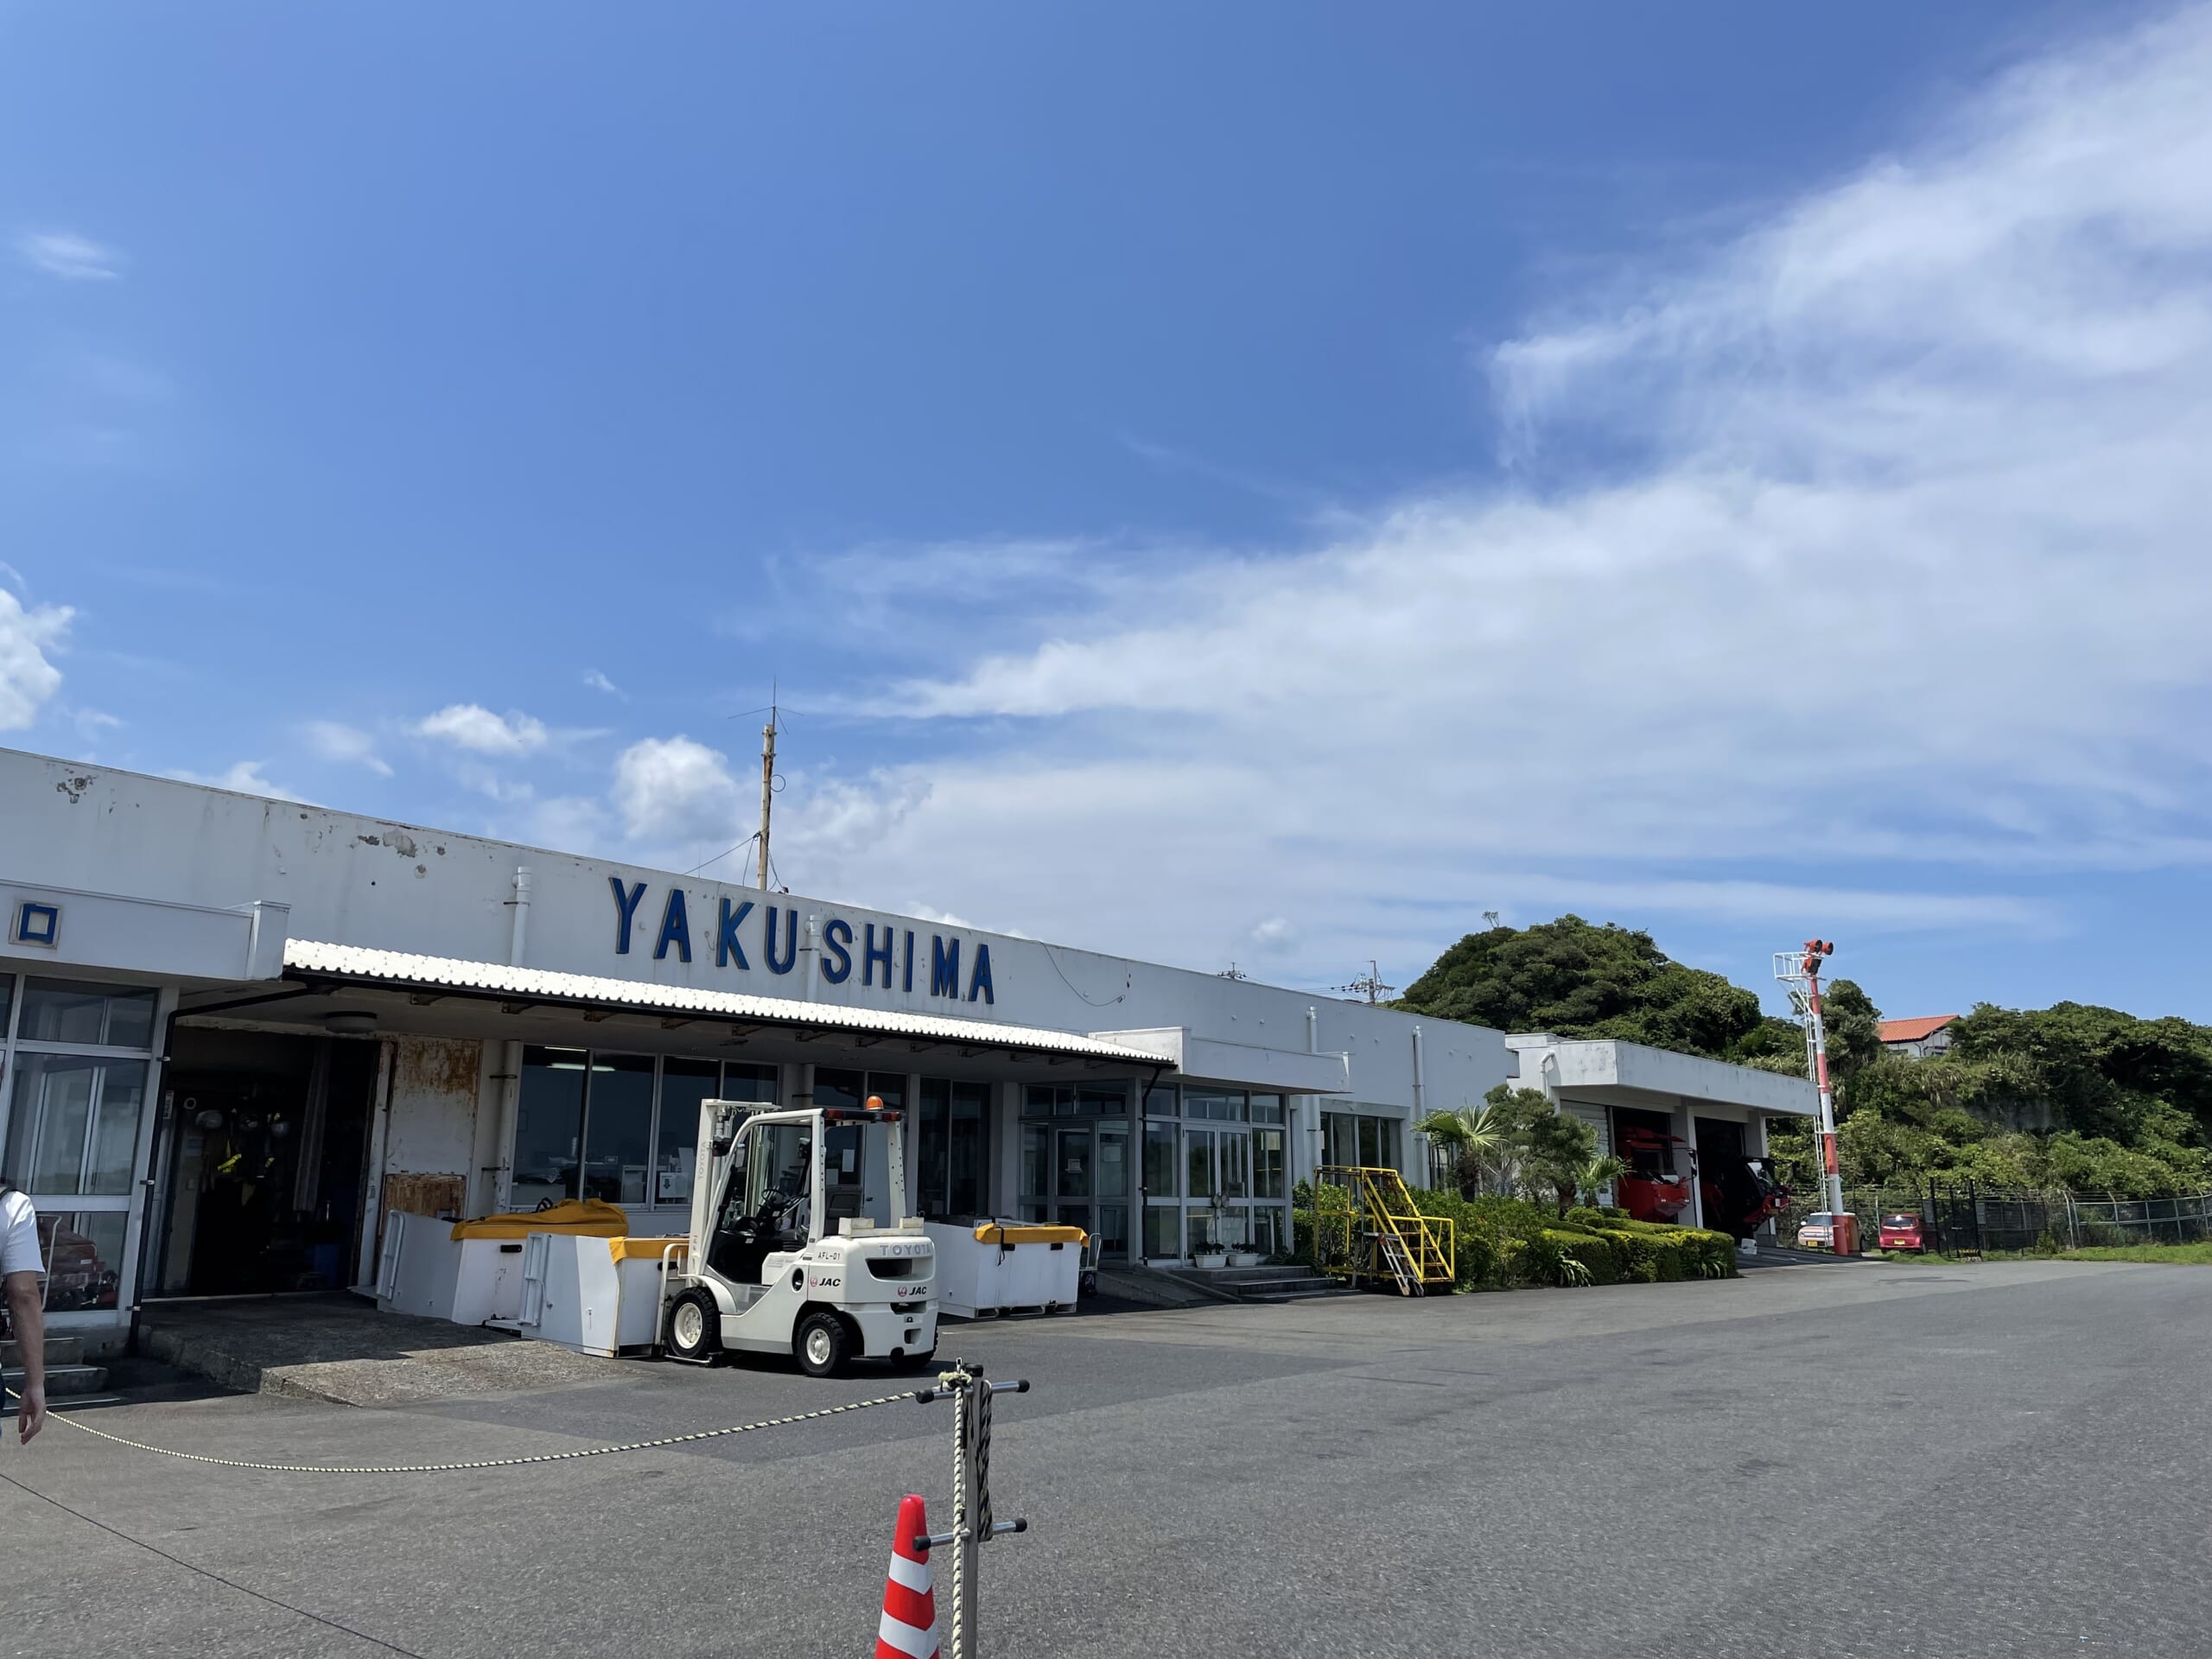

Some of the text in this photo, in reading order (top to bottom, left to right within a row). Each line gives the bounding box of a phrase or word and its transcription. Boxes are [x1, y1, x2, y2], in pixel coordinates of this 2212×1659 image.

[608, 877, 995, 1004] YAKUSHIMA
[698, 1141, 707, 1181] TOYOTA
[879, 1244, 931, 1256] TOYOTA
[817, 1251, 841, 1261] AFL-01
[819, 1278, 842, 1287] JAC
[908, 1286, 927, 1295] JAC
